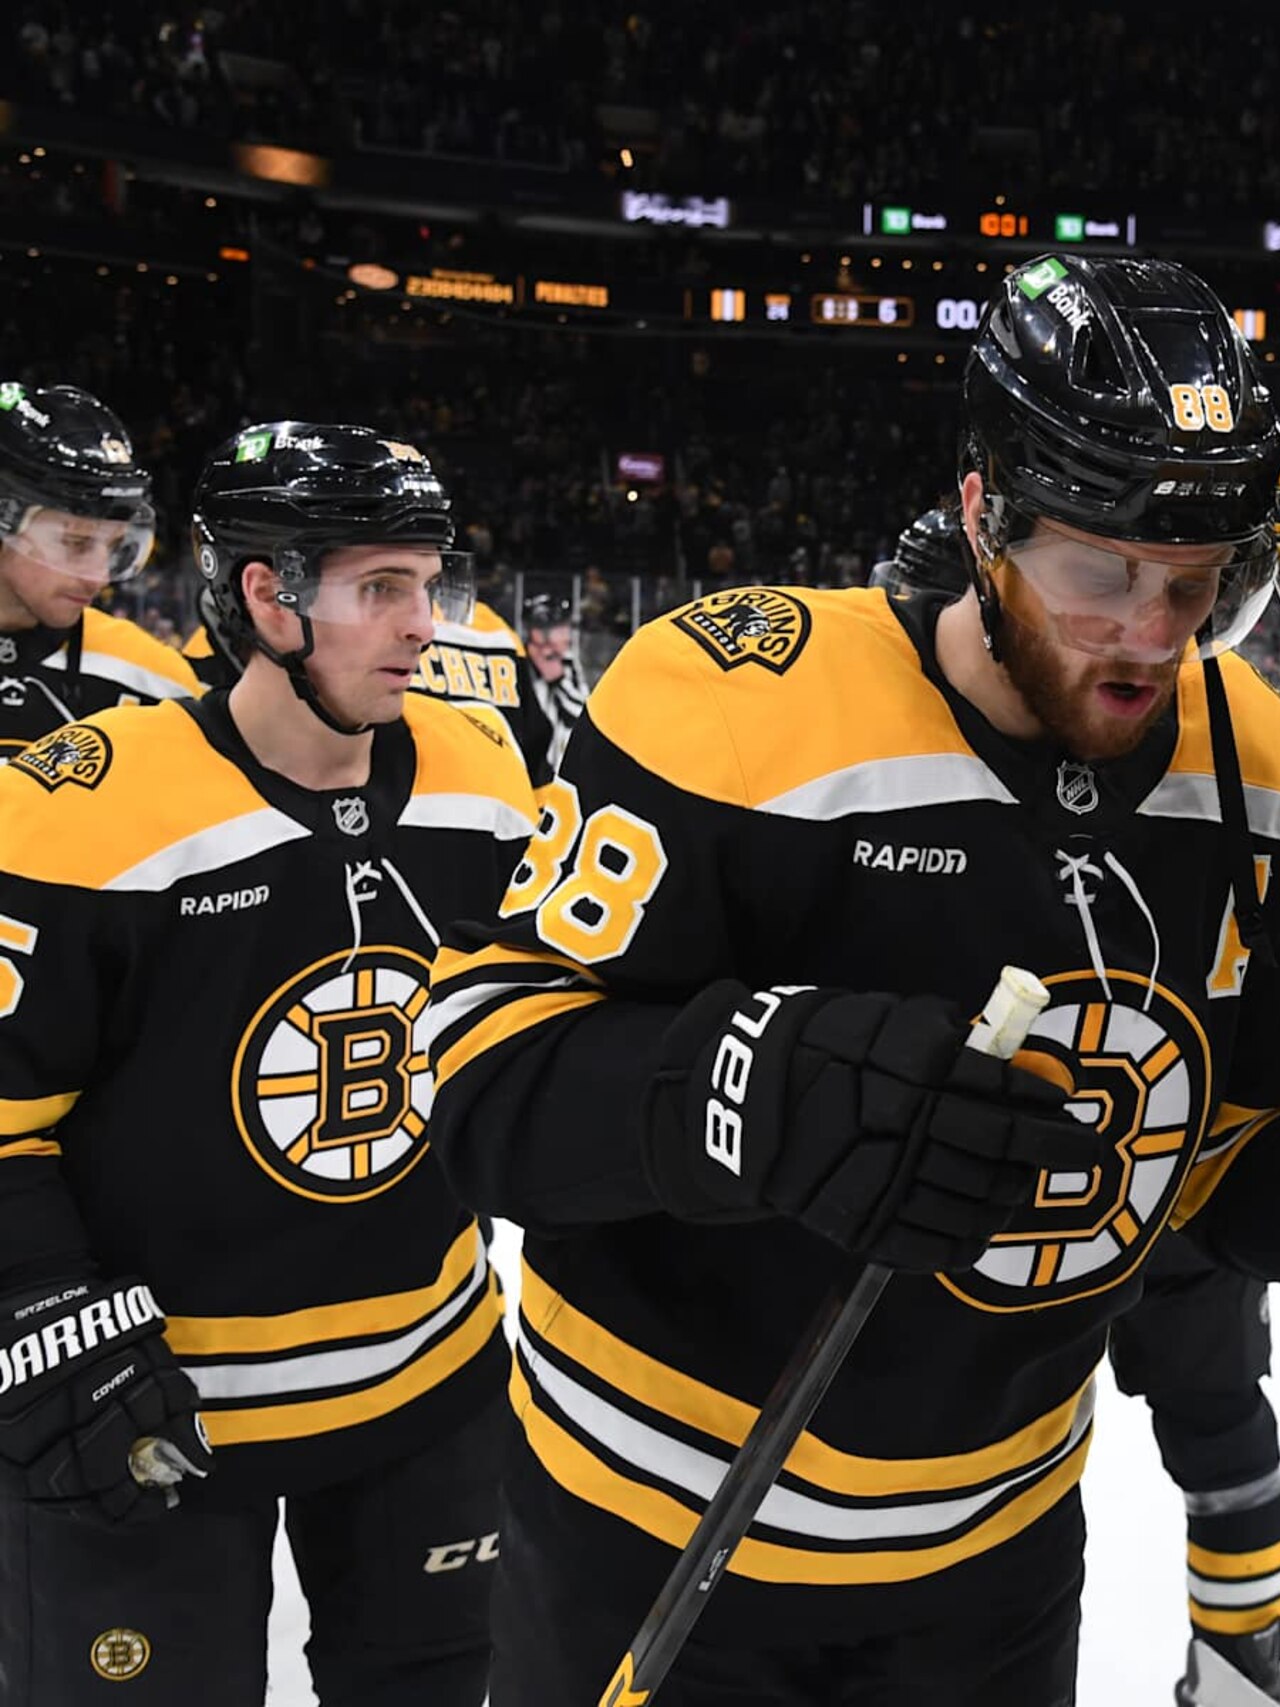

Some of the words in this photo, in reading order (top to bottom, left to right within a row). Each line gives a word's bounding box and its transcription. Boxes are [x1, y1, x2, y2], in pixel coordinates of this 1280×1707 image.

[1047, 283, 1093, 329] Bank
[1170, 384, 1234, 433] 88
[499, 773, 669, 965] 88
[310, 1002, 412, 1150] B
[92, 1364, 137, 1403] COVERT
